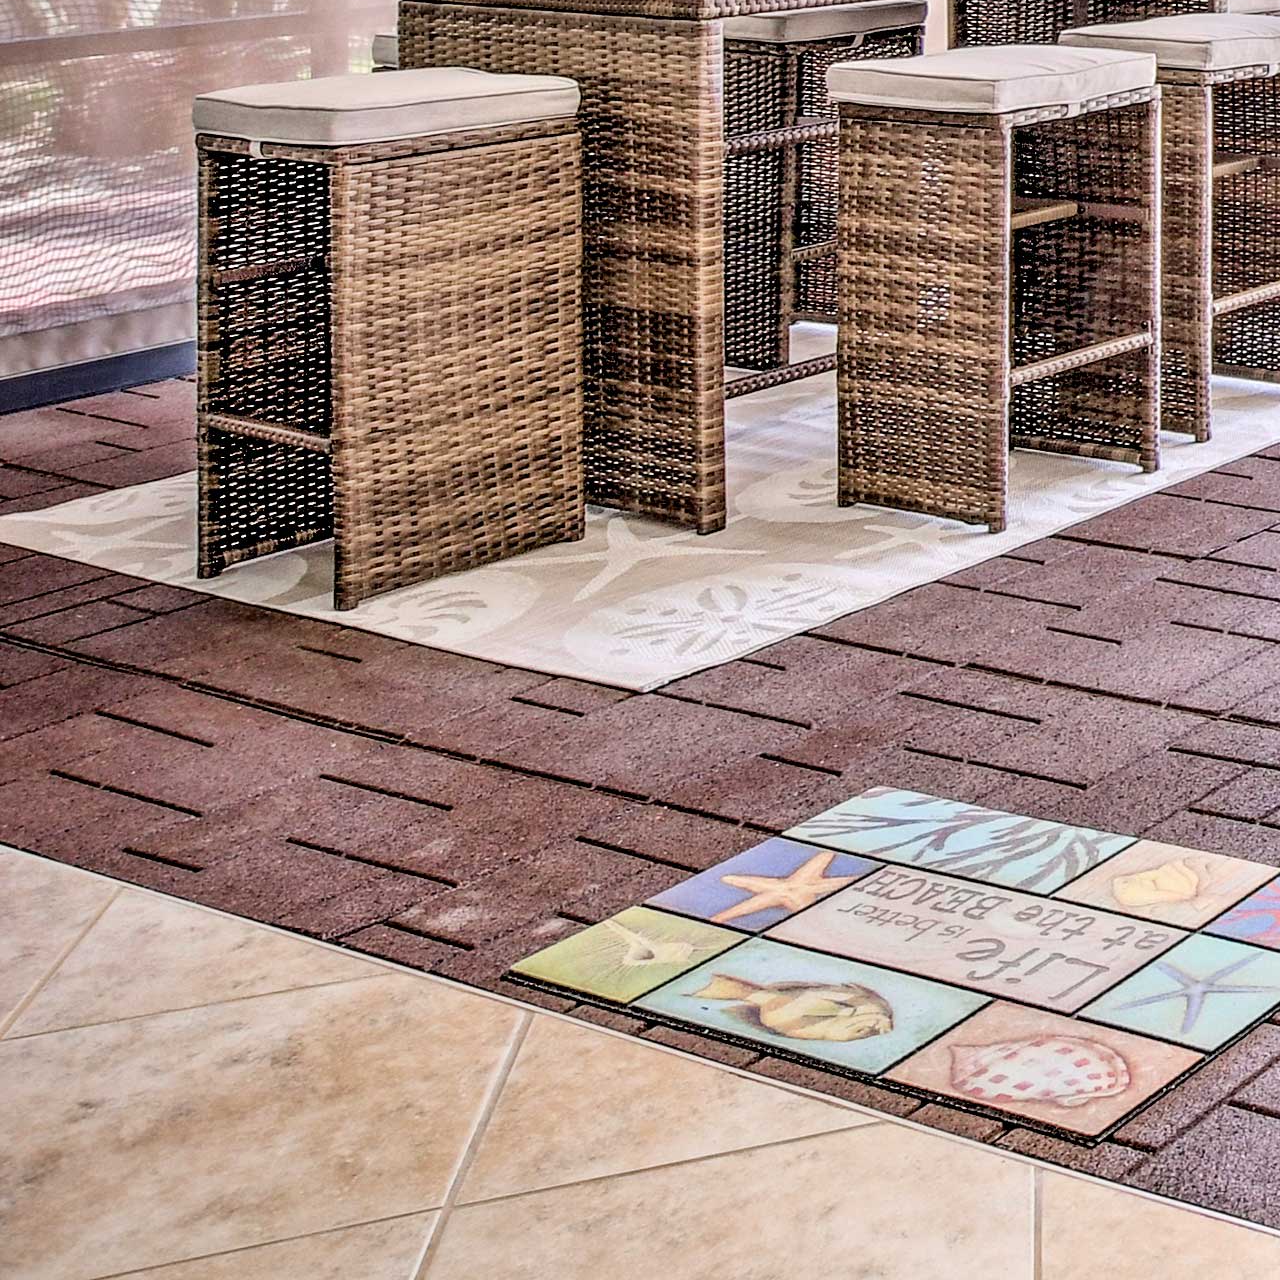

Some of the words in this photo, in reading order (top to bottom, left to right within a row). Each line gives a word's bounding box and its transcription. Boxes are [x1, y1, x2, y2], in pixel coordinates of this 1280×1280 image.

[853, 869, 1014, 921] BEACH
[836, 903, 938, 942] better
[937, 925, 971, 944] is
[1013, 904, 1096, 941] the
[1101, 925, 1170, 950] at
[955, 937, 1110, 1000] Life
